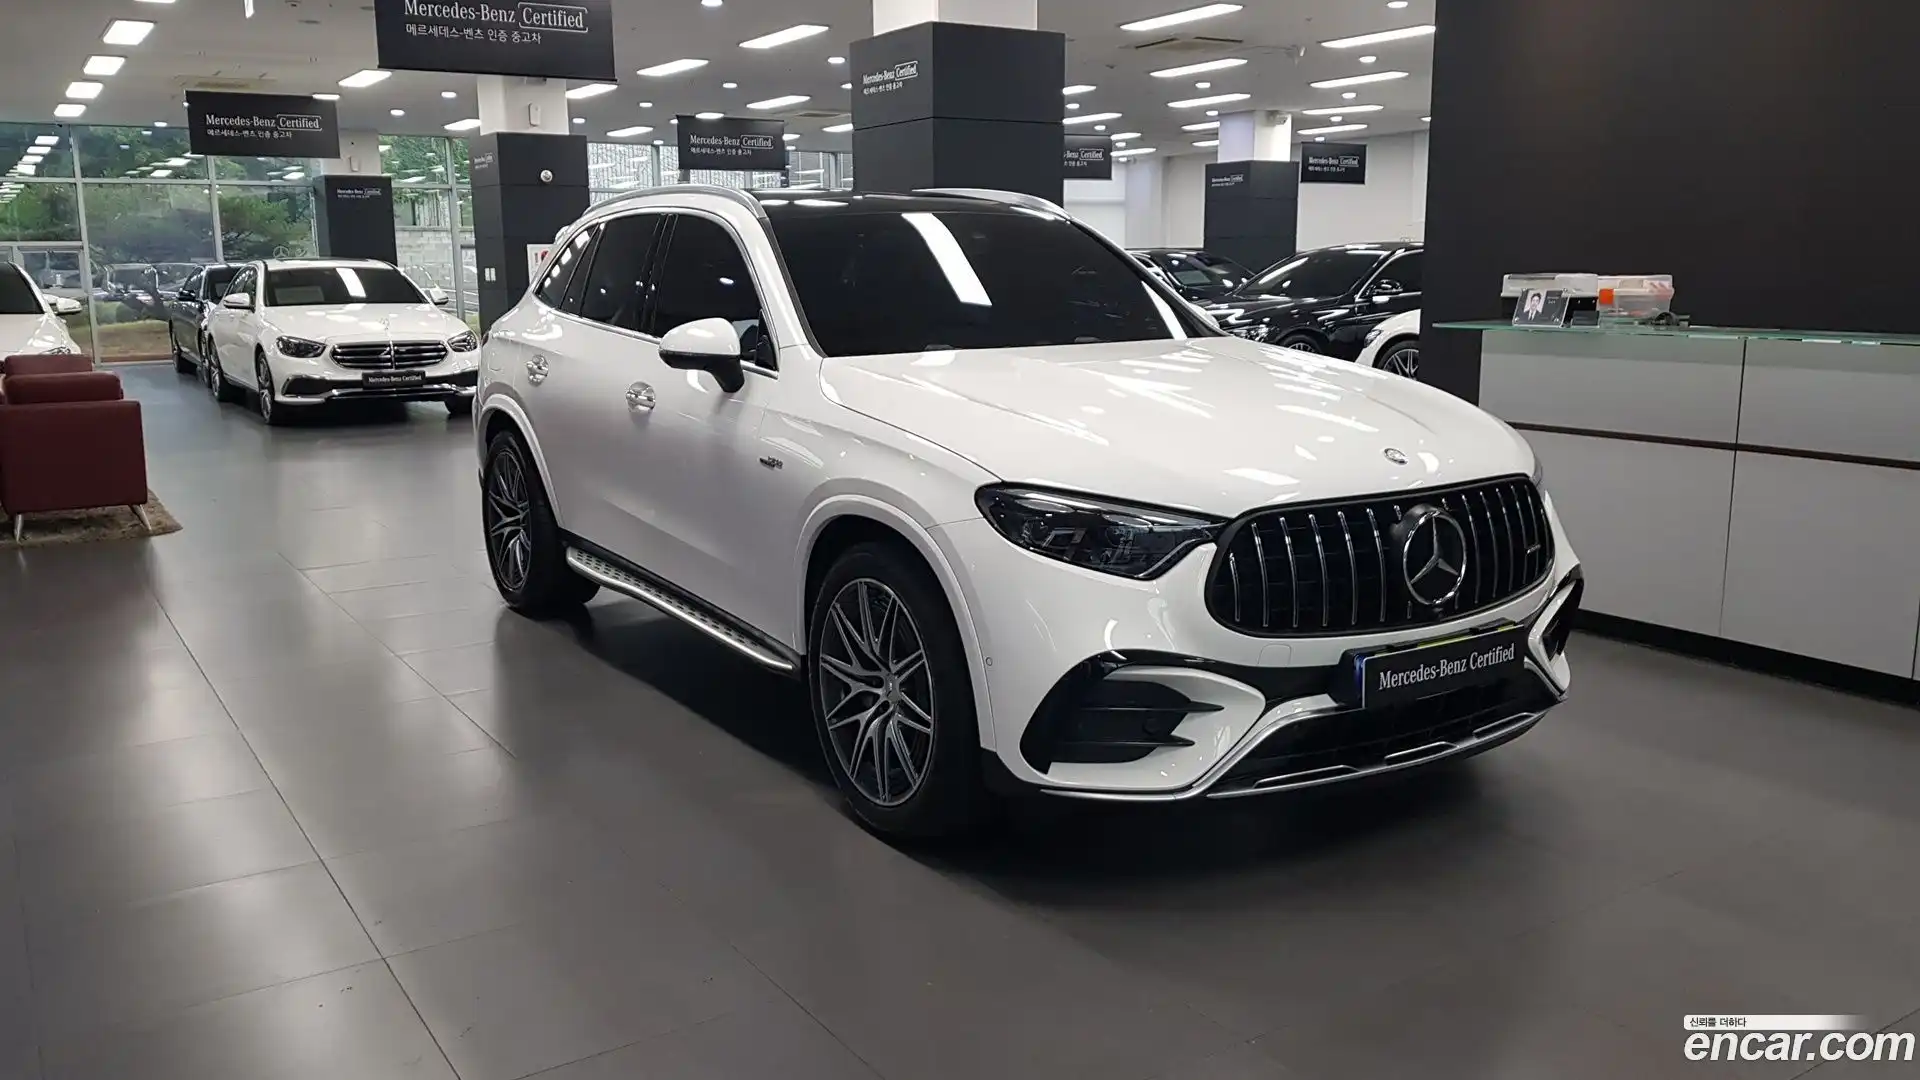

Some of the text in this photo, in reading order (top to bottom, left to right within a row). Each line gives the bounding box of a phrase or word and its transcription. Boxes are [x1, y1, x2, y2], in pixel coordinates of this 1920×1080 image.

[404, 0, 584, 28] Mercedes-Benz Certified
[405, 23, 541, 44] 메르세데스-벤츠 인증 중고차
[205, 114, 320, 128] Mercedes-Benz Certified
[690, 134, 772, 147] Mercedes-Benz Certified
[1378, 642, 1515, 691] Mercedes-Benz Certified
